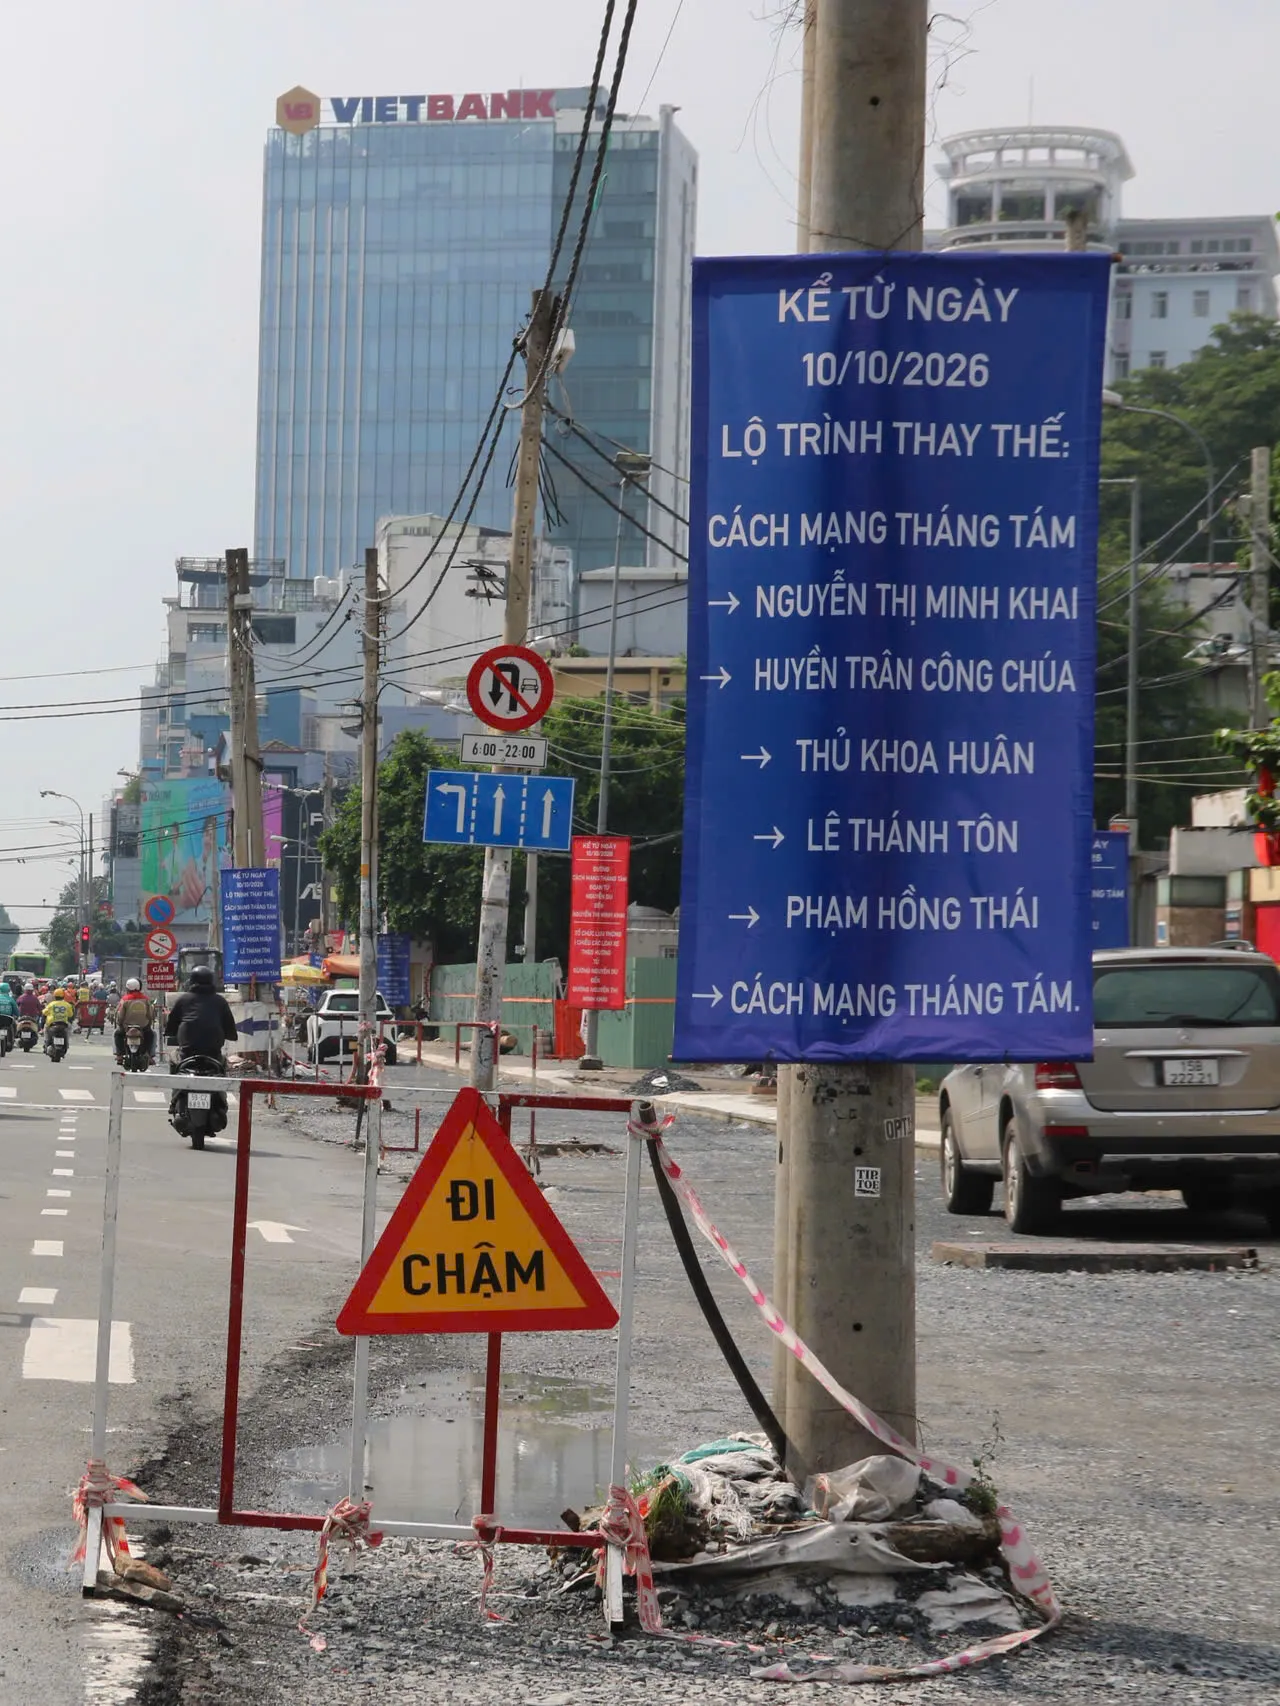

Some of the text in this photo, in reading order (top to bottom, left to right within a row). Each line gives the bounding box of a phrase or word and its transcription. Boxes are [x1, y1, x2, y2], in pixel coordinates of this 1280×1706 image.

[330, 90, 556, 122] VIETBANK
[778, 272, 1019, 322] KỂ TỪ NGÀY
[802, 351, 990, 386] 10/10/2026
[722, 412, 1071, 465] LỘ TRÌNH THAY THẾ:
[708, 505, 1076, 552] CÁCH MẠNG THÁNG TÁM
[756, 570, 1078, 626] NGUYỄN THỊ MINH KHAI
[754, 644, 1076, 692] HUYỀN TRÂN CÔNG CHÚA
[796, 726, 1034, 774] THỦ KHOA HUÂN
[807, 811, 1018, 852] LÊ THÁNH TÔN
[786, 884, 1039, 936] PHẠM HỒNG THÁI
[730, 972, 1080, 1024] CÁCH MẠNG THÁNG TÁM.
[446, 1179, 495, 1222] ĐI
[857, 1180, 878, 1189] TOE
[402, 1241, 545, 1298] CHẬM
